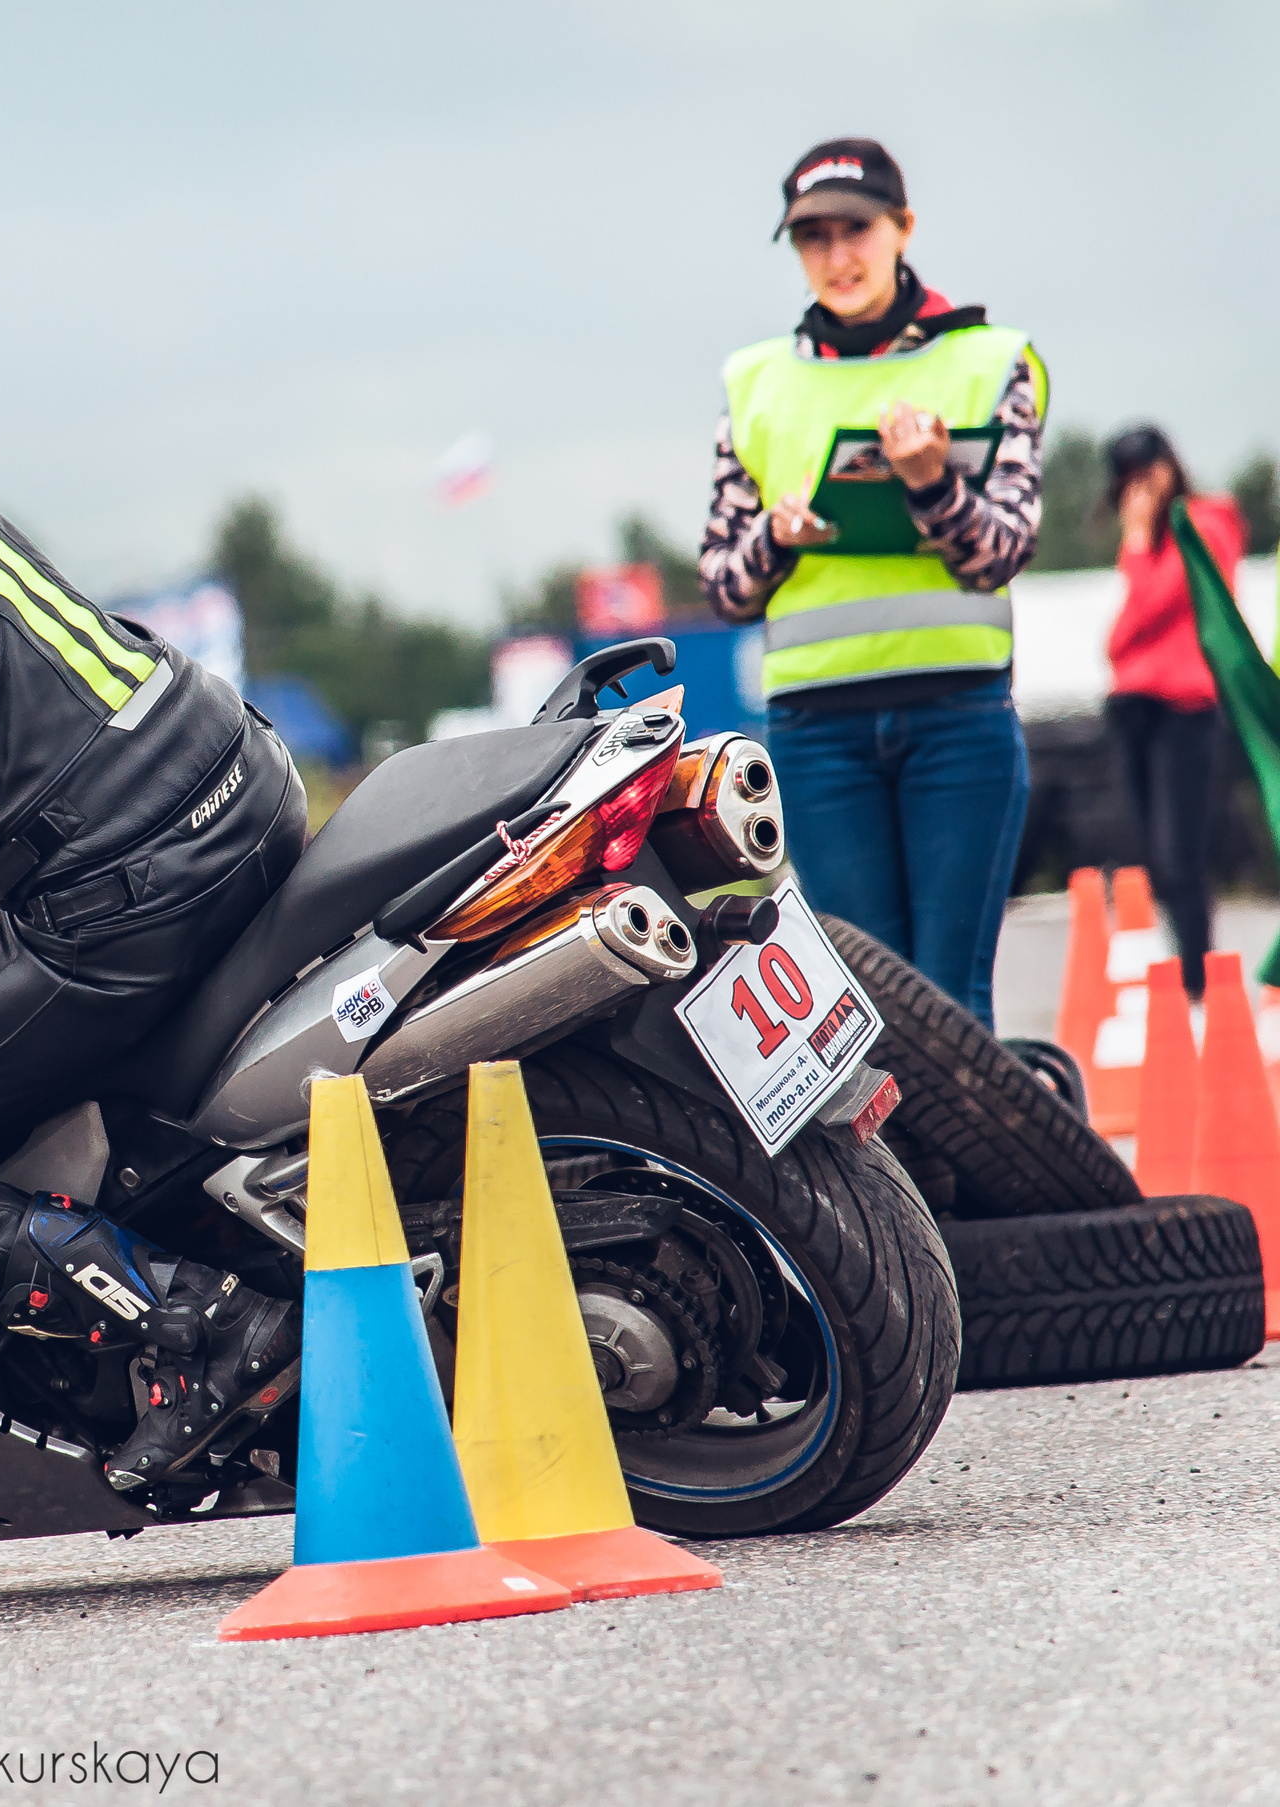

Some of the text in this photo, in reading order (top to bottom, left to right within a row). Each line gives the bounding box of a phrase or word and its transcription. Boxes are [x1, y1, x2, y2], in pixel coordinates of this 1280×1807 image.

[191, 763, 243, 829] DAINESE
[350, 996, 385, 1028] SPB
[731, 942, 814, 1060] 10
[812, 1019, 838, 1051] МОТО
[821, 1008, 866, 1068] ДЖИМХАНА
[755, 1068, 797, 1112] Мотошкола
[766, 1068, 820, 1128] moto-a.ru
